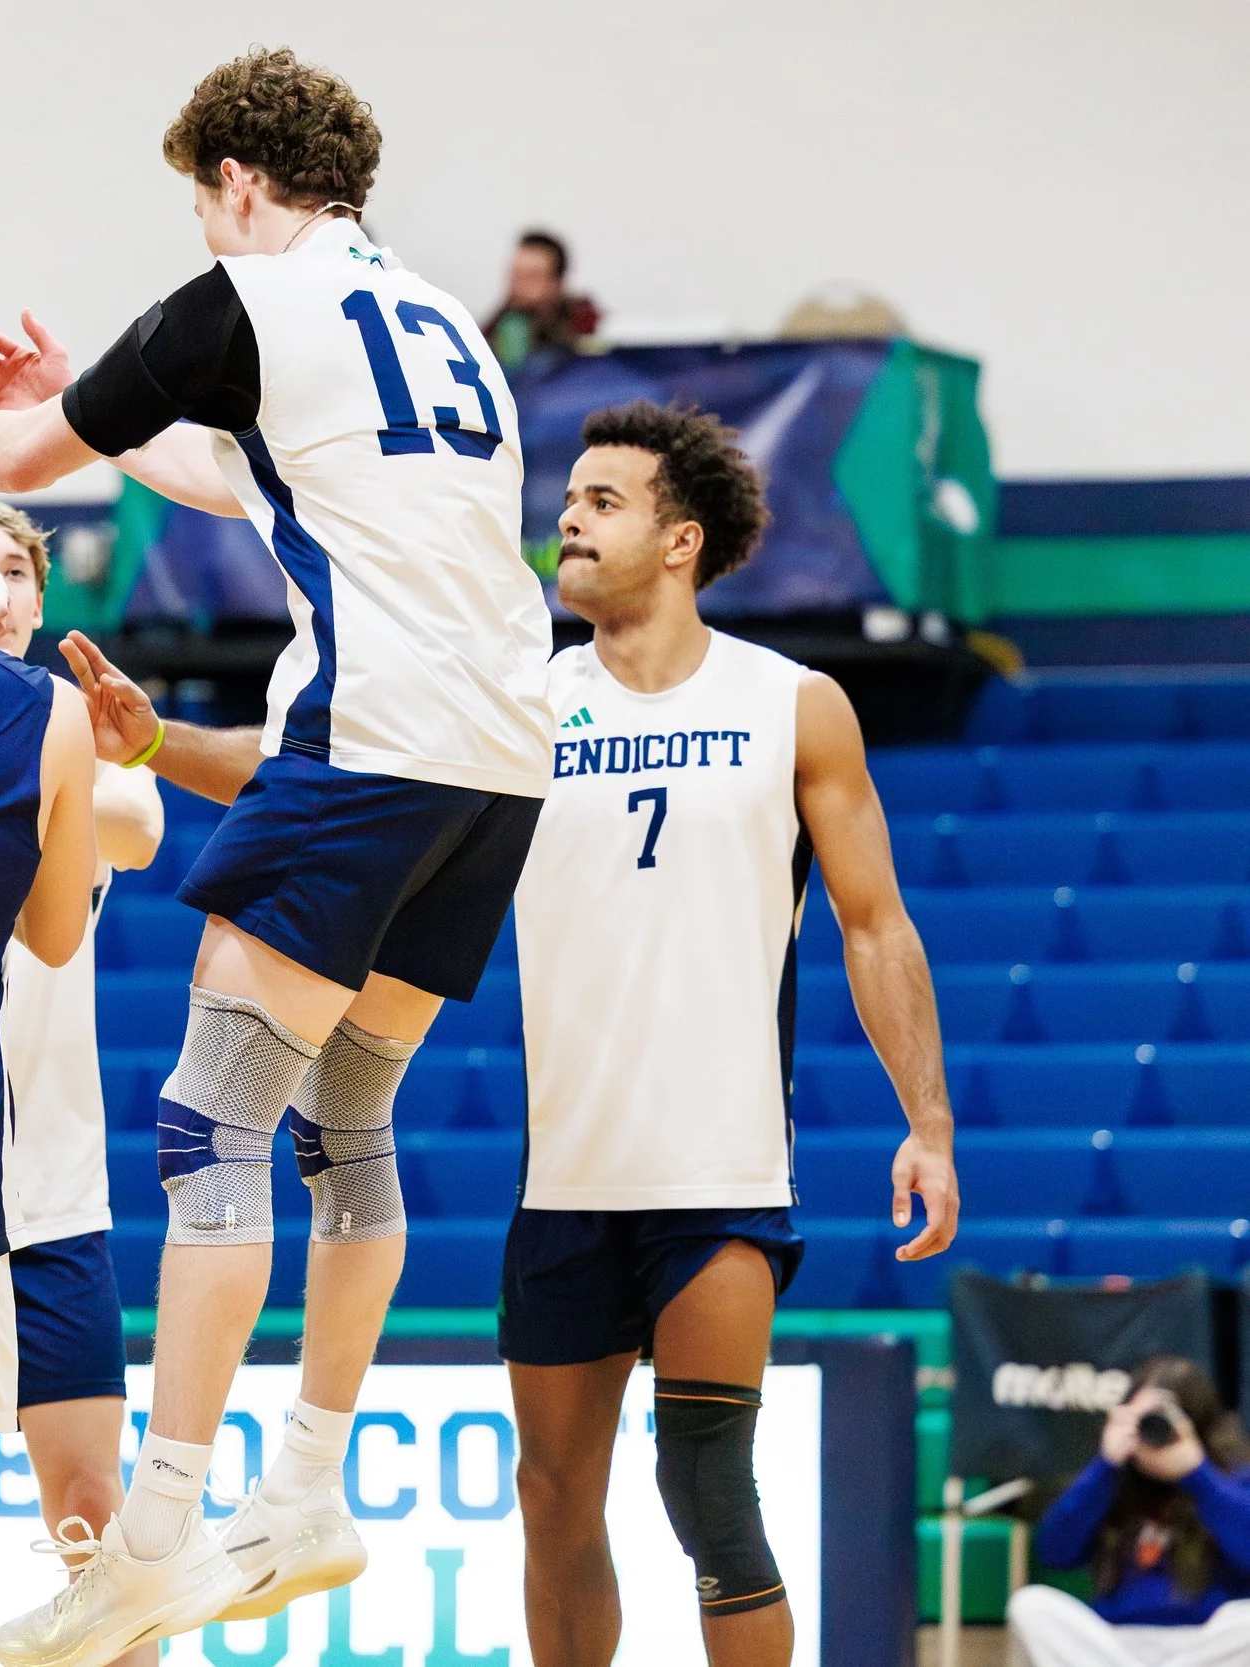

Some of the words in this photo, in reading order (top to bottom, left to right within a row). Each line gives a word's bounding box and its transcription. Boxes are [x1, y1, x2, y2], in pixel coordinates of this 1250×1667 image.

[340, 289, 503, 461] 13
[553, 731, 750, 779] ENDICOTT
[628, 787, 667, 869] 7
[992, 1361, 1131, 1412] molte
